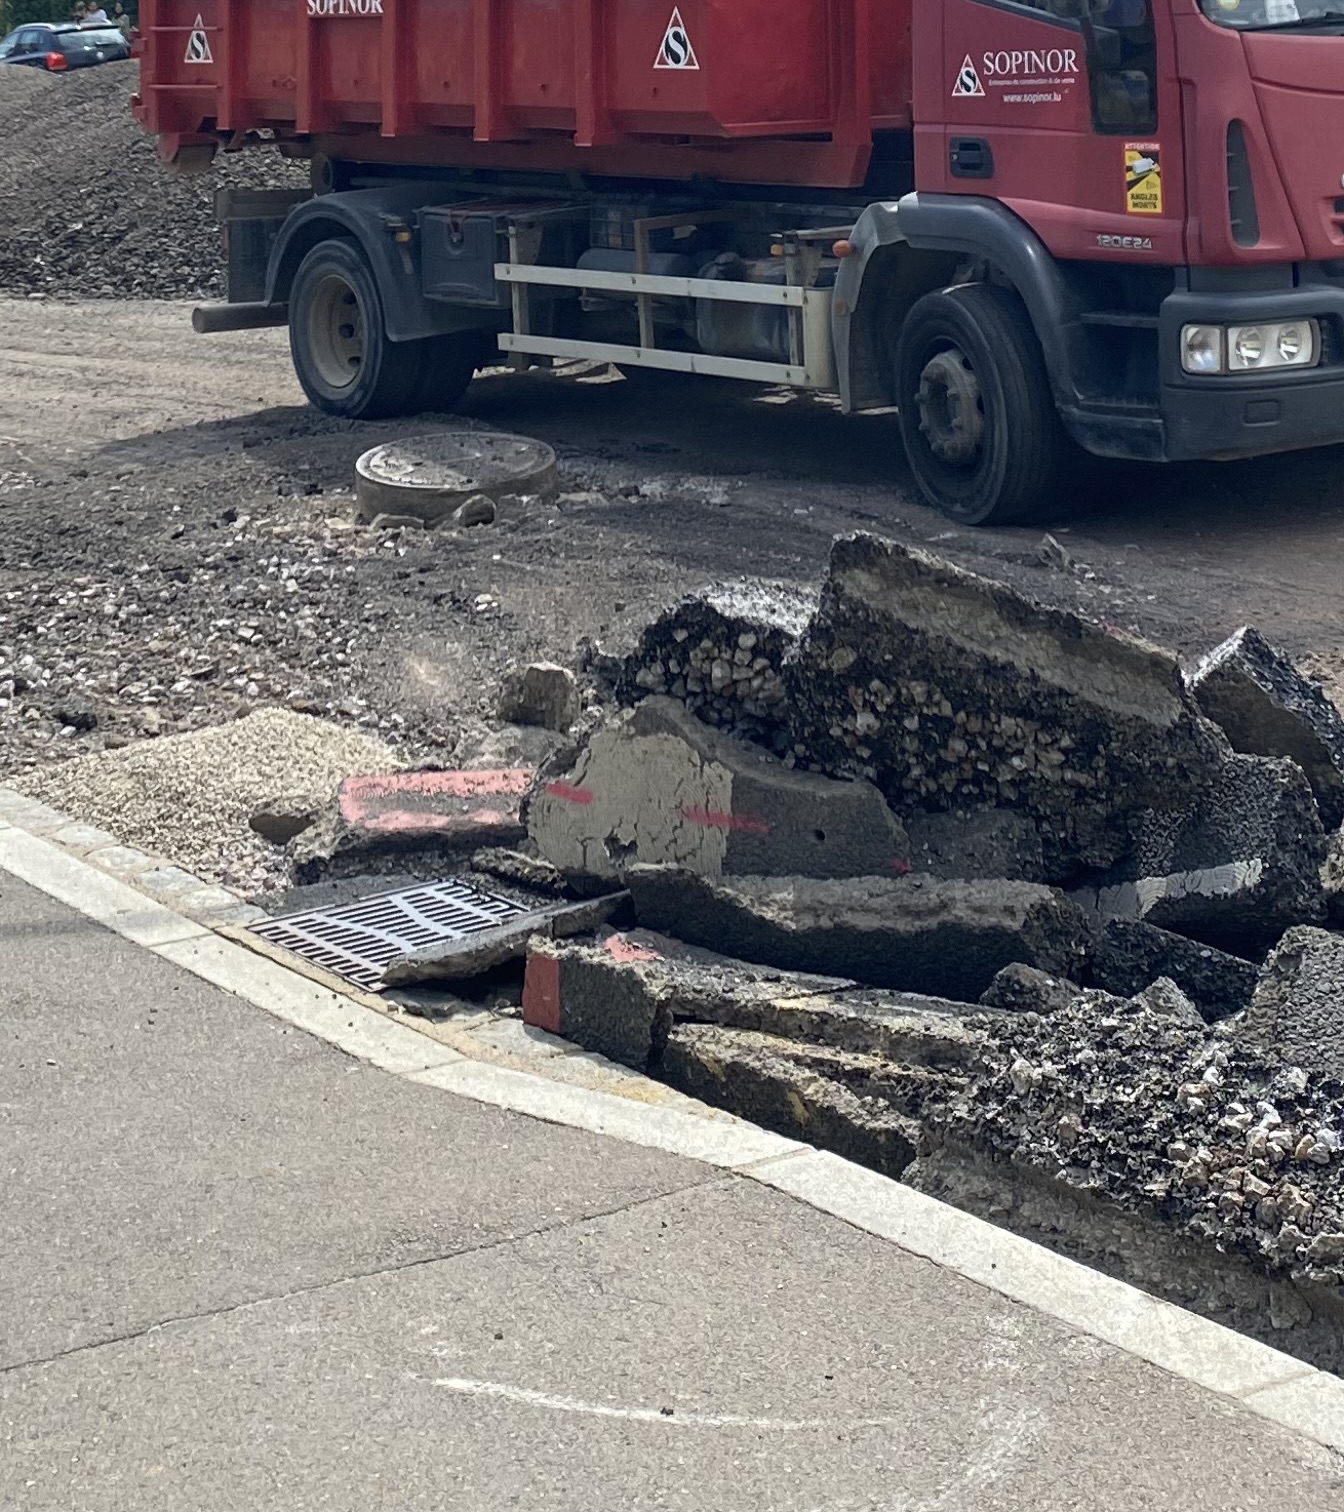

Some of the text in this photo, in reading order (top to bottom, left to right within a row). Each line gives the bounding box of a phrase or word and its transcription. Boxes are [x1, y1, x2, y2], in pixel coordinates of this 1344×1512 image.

[983, 49, 1079, 76] SOPINOR
[1003, 91, 1061, 104] www.sopinor.lu
[1131, 193, 1158, 201] ANGLES
[1097, 235, 1152, 249] 120E24
